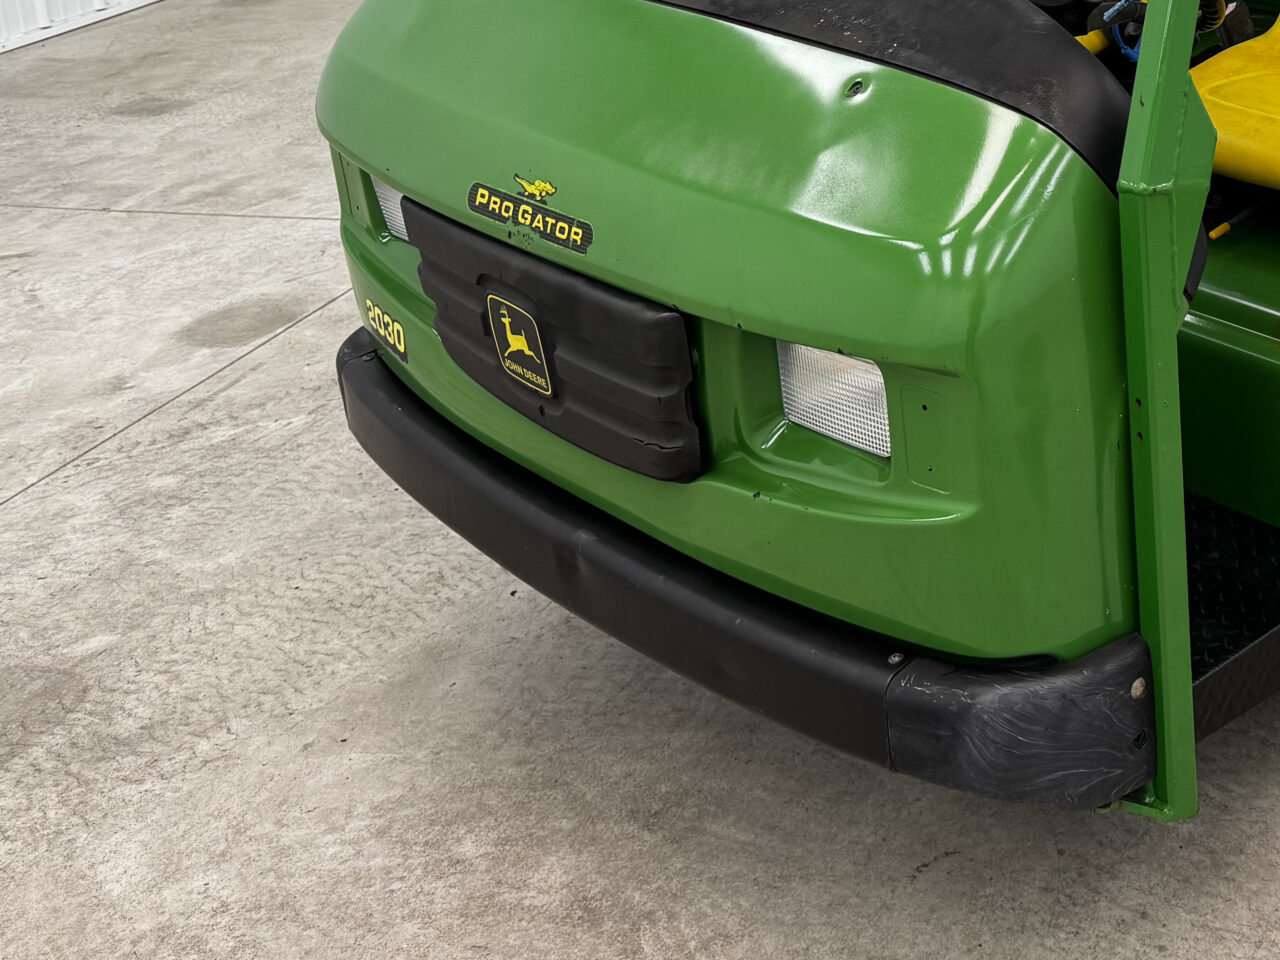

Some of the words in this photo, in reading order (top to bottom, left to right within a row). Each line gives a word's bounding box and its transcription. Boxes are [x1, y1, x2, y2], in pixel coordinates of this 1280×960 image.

[475, 187, 514, 218] PRO
[517, 204, 583, 246] GATOR
[366, 298, 405, 353] 2030
[504, 358, 523, 376] JOHN
[523, 368, 548, 389] DEERE
